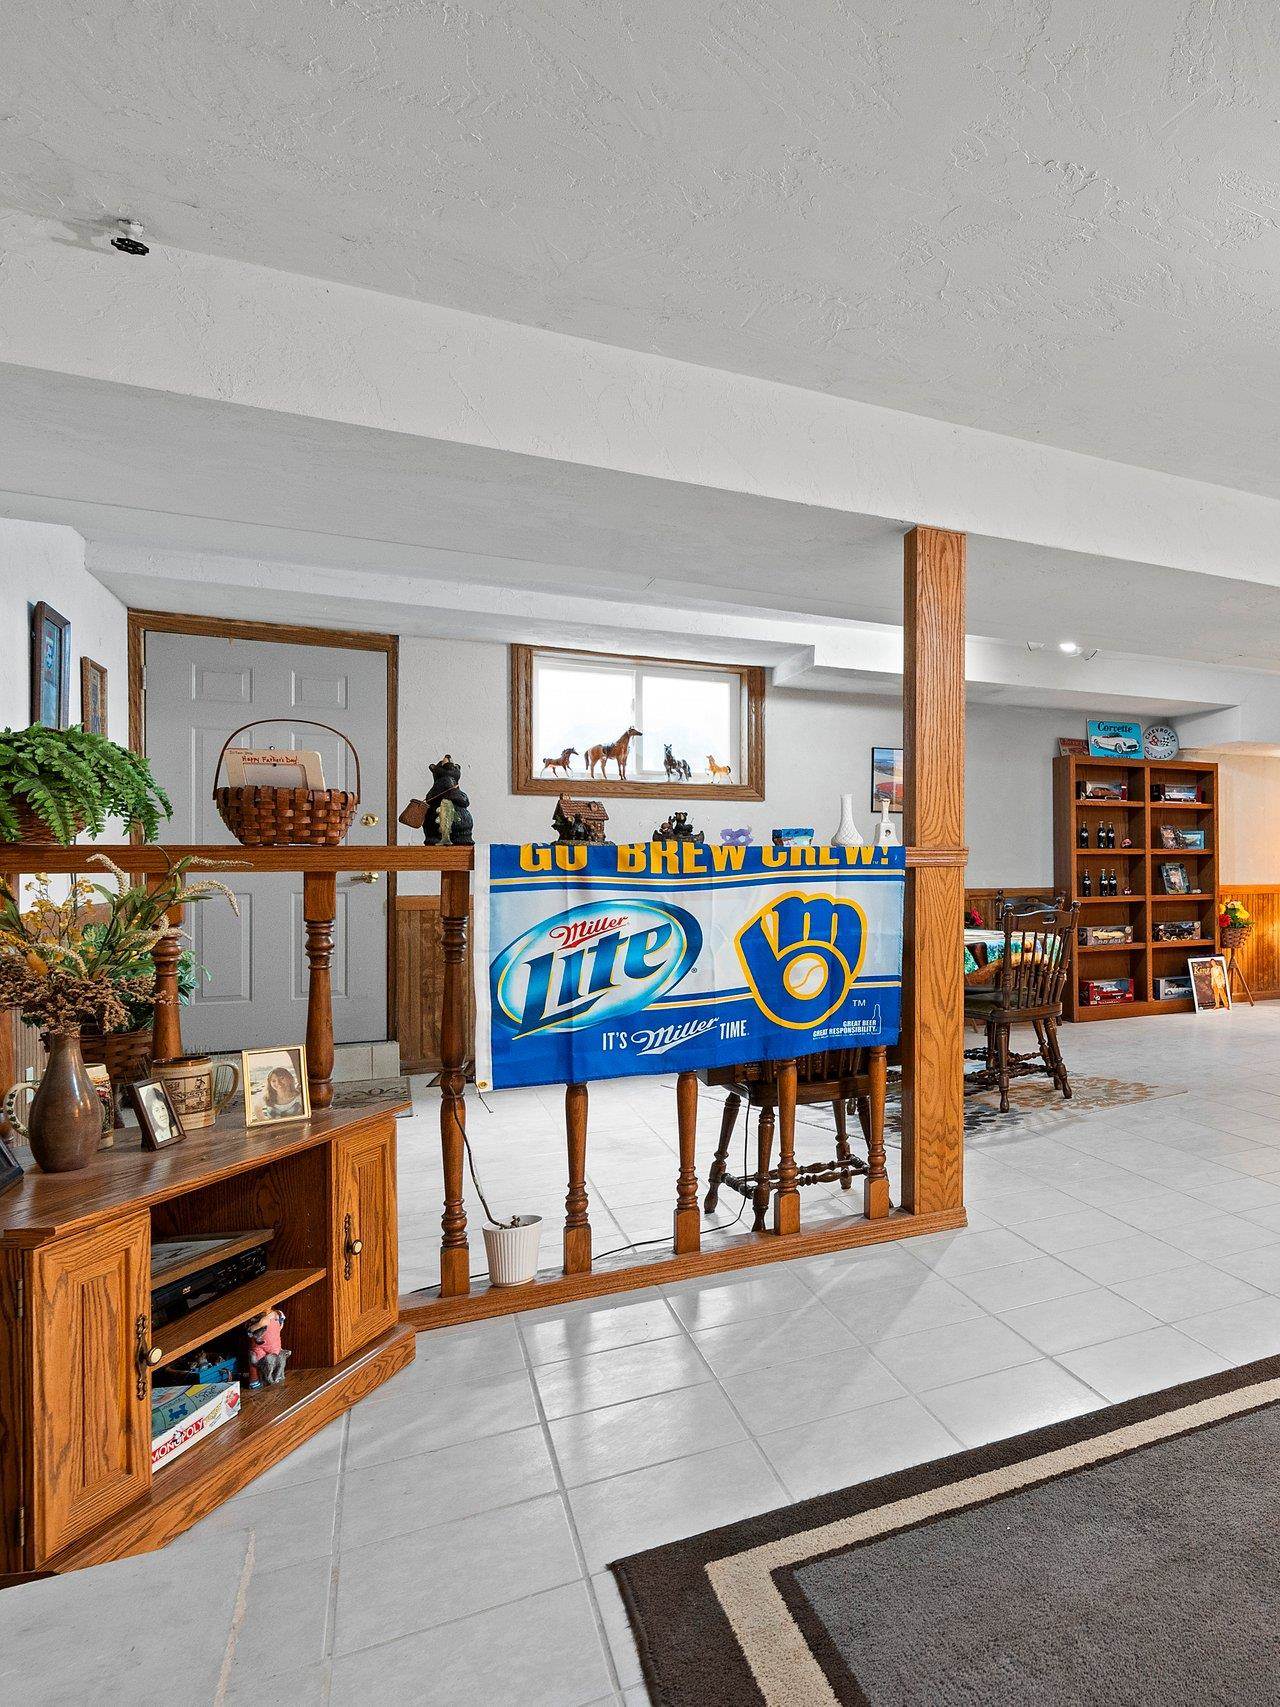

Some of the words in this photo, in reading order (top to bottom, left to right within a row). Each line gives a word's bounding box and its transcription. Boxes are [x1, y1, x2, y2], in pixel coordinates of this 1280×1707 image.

[1098, 722, 1133, 733] Corvette
[1145, 728, 1176, 742] CHEVROLET
[519, 843, 588, 872] GO
[617, 841, 747, 875] BREW
[549, 916, 629, 951] Miller
[515, 923, 673, 1039] Lite
[602, 1031, 628, 1051] IT'S
[630, 1016, 720, 1056] Miller
[812, 1029, 828, 1038] GREAT
[843, 1020, 861, 1028] GREAT
